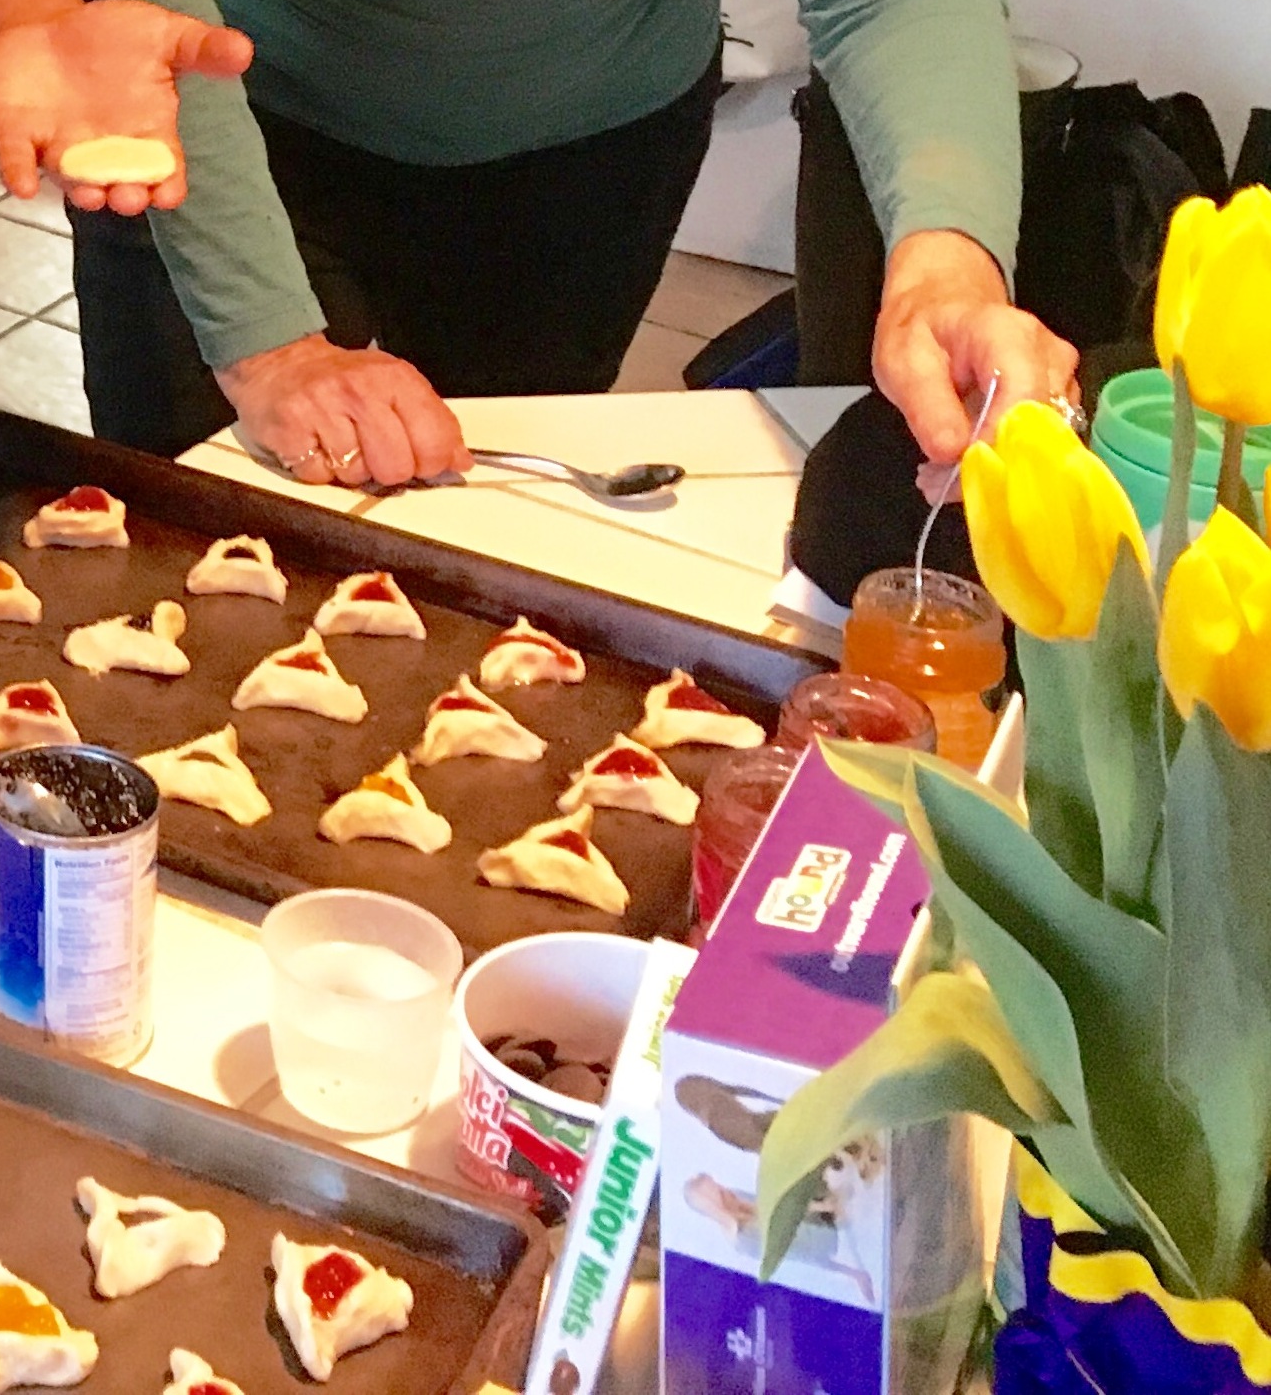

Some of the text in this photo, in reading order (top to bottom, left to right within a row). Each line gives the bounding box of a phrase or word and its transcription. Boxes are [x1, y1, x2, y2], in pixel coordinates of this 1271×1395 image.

[774, 849, 844, 927] hond
[560, 1116, 654, 1339] Junior Mints
